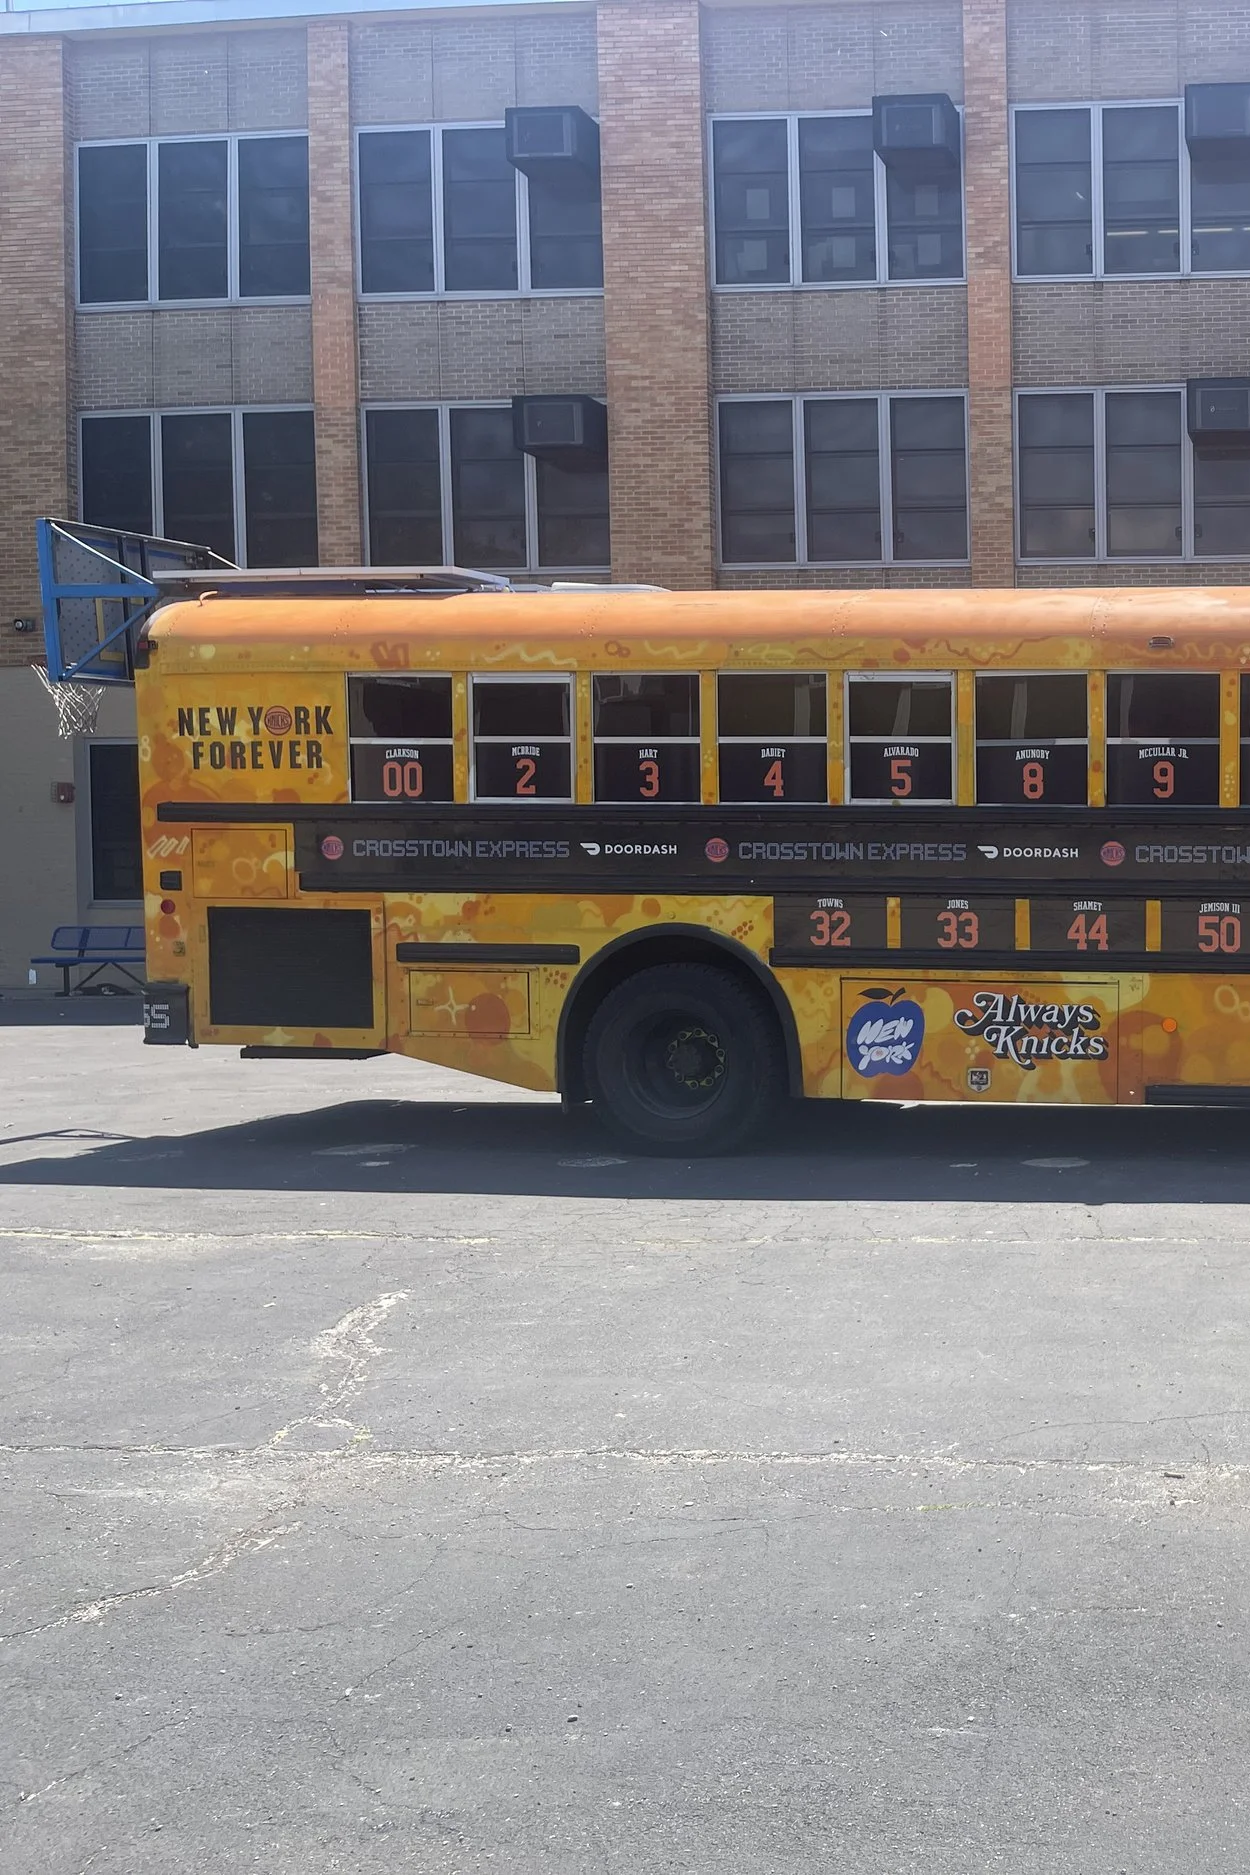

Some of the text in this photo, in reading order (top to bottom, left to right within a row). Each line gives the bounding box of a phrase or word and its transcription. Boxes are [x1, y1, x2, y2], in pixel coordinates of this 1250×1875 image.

[178, 706, 237, 737] NEW
[192, 740, 323, 770] FOREVER
[385, 748, 419, 759] CLARKSON
[511, 746, 540, 757] MCBRIDE
[639, 748, 658, 759] HART
[883, 746, 919, 758] ALVARADO
[1015, 749, 1051, 760] ANUNOBY
[1138, 747, 1176, 759] MCCULLAR
[382, 761, 423, 797] 00
[516, 758, 536, 795] 2
[639, 760, 660, 797] 3
[763, 760, 785, 797] 4
[890, 759, 912, 796] 5
[1022, 762, 1044, 799] 8
[1153, 761, 1175, 798] 9
[352, 839, 472, 858] CROSSTOWN
[475, 840, 570, 858] EXPRESS
[604, 844, 678, 855] DOORDASH
[738, 842, 864, 861] CROSSTOWN
[868, 842, 967, 861] EXPRESS
[1003, 847, 1079, 858] DOORDASH
[817, 898, 843, 909] TOWNS
[947, 899, 969, 910] JONES
[1073, 900, 1102, 912] SHAMET
[1198, 902, 1241, 915] JEMISON III
[810, 911, 851, 947] 32
[936, 911, 979, 949] 33
[1067, 914, 1109, 950] 44
[1198, 915, 1242, 953] 50
[953, 991, 1097, 1033] Always
[856, 1016, 914, 1045] NEW
[983, 1025, 1106, 1066] Knicks
